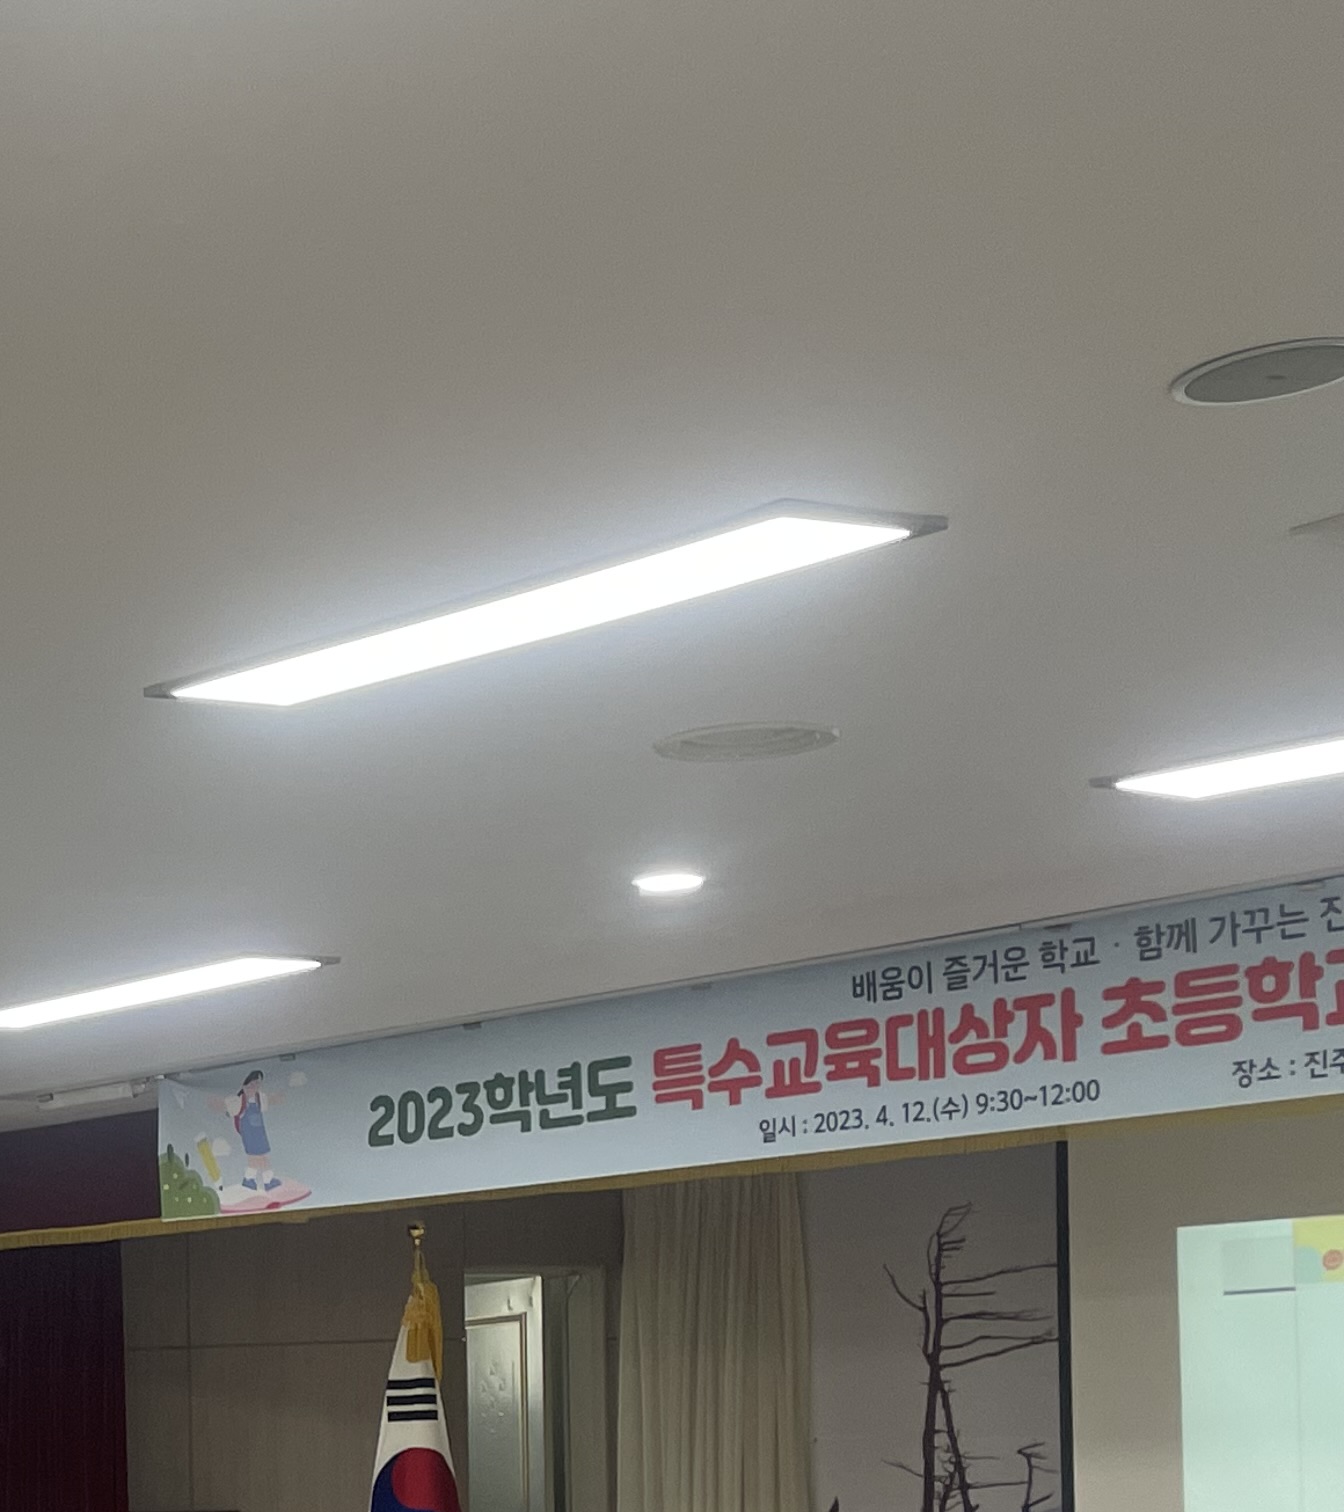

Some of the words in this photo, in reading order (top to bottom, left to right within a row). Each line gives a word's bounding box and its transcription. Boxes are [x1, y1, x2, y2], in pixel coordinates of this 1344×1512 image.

[851, 960, 934, 1004] 배움이
[942, 946, 1030, 990] 즐거운
[1038, 935, 1101, 975] 학교
[1133, 917, 1198, 961] 함께
[1209, 903, 1310, 948] 가꾸는
[368, 1055, 637, 1148] 2023학년도
[651, 987, 1084, 1111] 특수교육대상자
[1232, 1057, 1282, 1088] 장소
[758, 1115, 797, 1144] 일시
[813, 1109, 870, 1134] 2023.
[875, 1106, 895, 1128] 4.
[902, 1094, 969, 1124] 12.(수)
[975, 1079, 1101, 1115] 9:30~12:00
